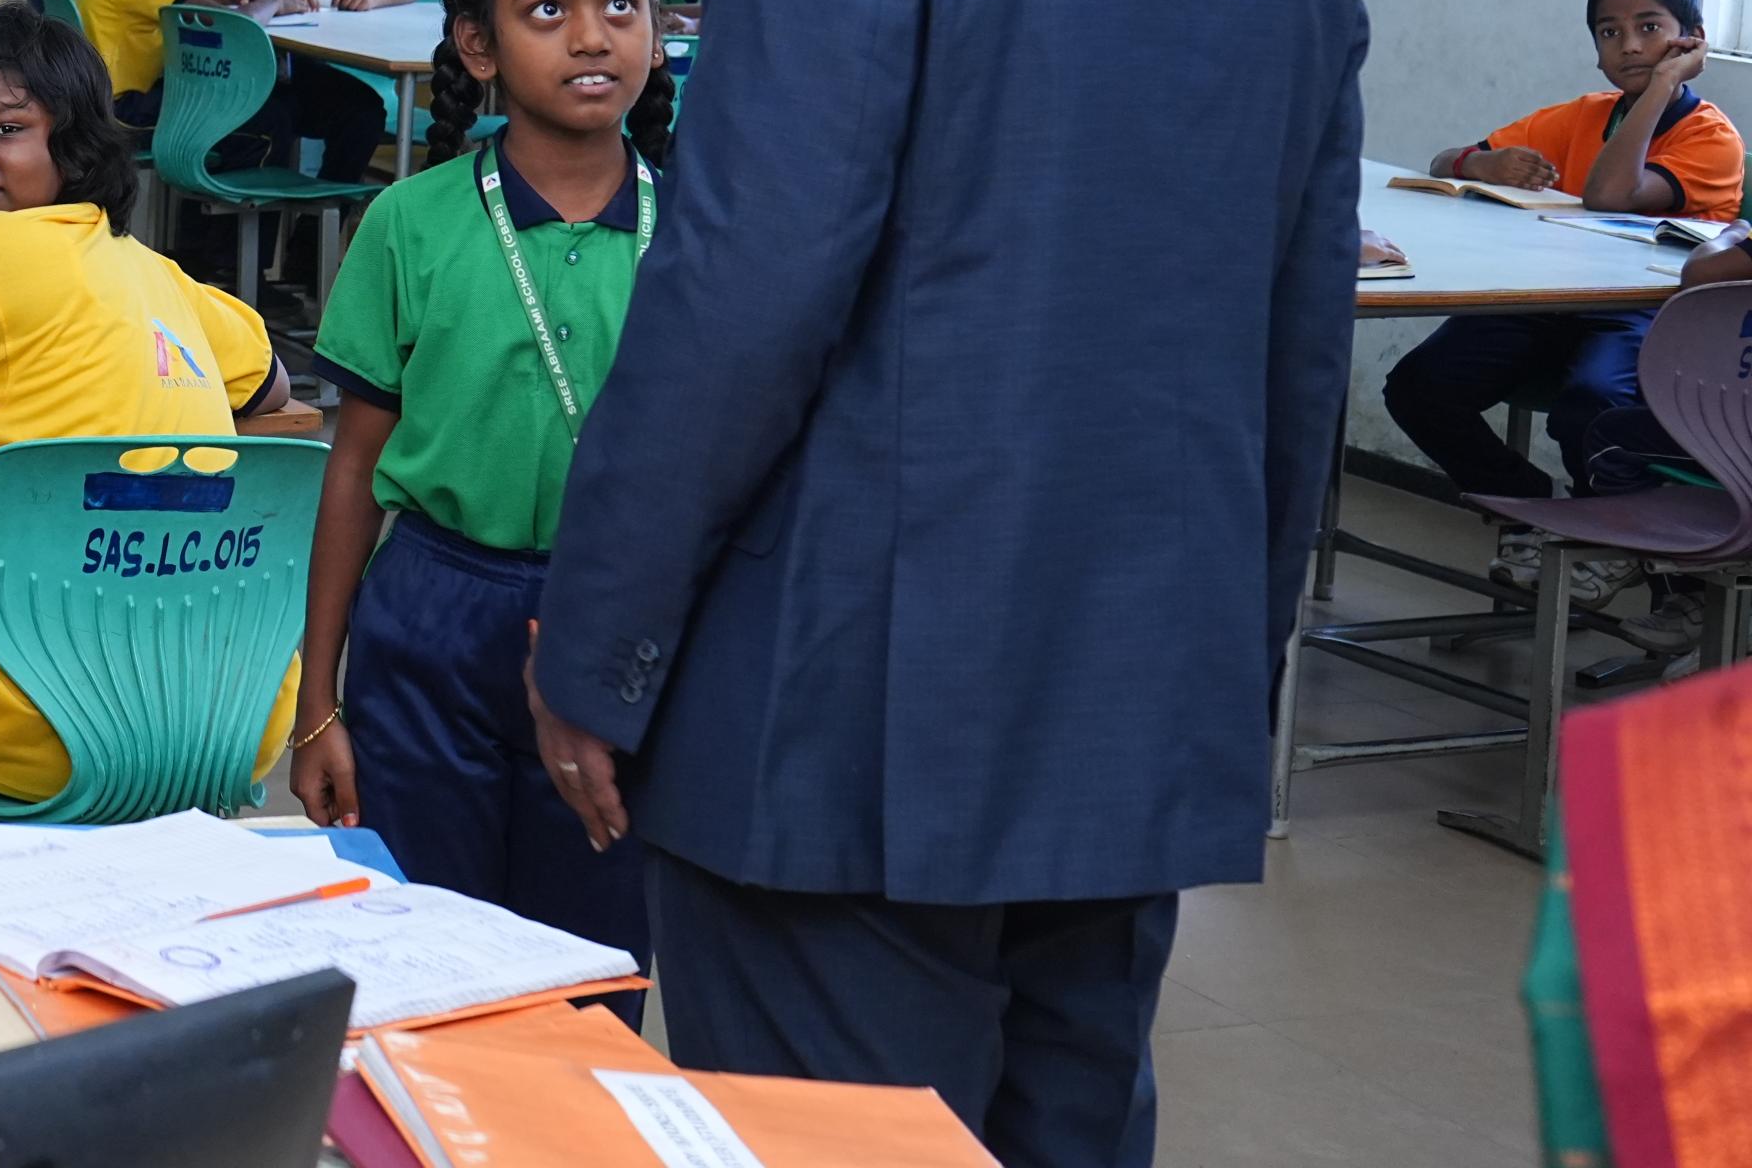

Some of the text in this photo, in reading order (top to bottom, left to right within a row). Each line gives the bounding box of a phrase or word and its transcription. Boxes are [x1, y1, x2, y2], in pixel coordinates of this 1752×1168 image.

[493, 203, 577, 416] SREE ABIRAAMI SCHOOL (CBSE)
[82, 525, 263, 577] SAS.LC.015
